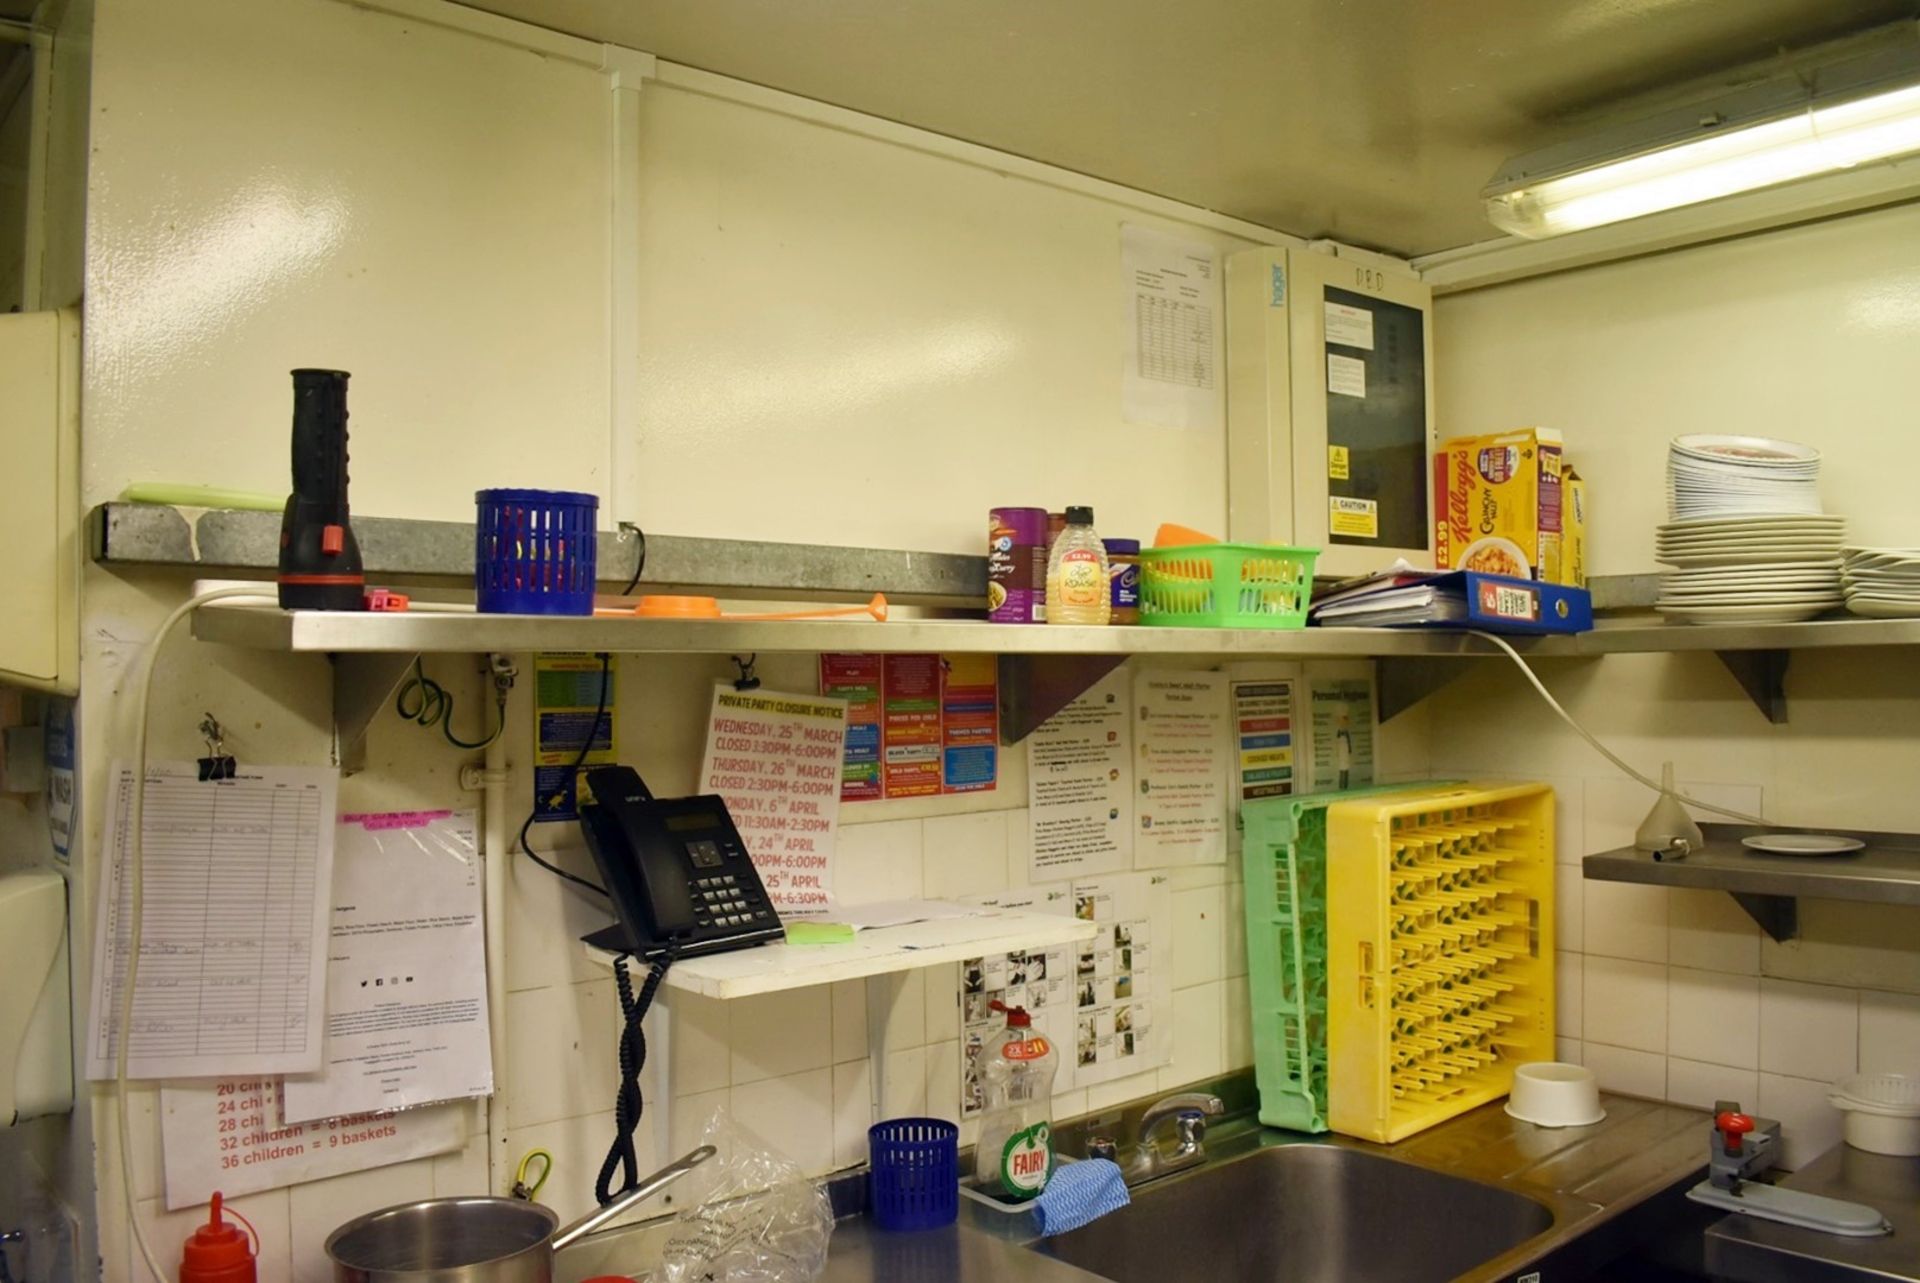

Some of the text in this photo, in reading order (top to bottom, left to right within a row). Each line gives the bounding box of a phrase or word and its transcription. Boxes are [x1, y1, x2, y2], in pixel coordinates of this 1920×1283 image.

[1340, 499, 1367, 511] CAUTION
[1450, 450, 1476, 543] Kellogg's
[1479, 487, 1495, 535] CRUNCHY
[1490, 498, 1499, 519] NUT
[1437, 520, 1448, 565] £2.99
[718, 694, 844, 719] PRIVATE PARTY CLOSURE NOTICE
[779, 722, 804, 739] 25TH
[804, 728, 843, 744] MARCH
[715, 737, 837, 759] CLOSED 3:30PM-6:00PM
[770, 758, 796, 775] 26TH
[796, 764, 835, 780] MARCH
[709, 774, 834, 796] CLOSED 2:30PM-6:00PM
[769, 795, 788, 813] 6TH
[789, 800, 819, 816] APRIL
[744, 815, 830, 833] 11:30AM-2:30PM
[759, 832, 784, 850] 24TH
[785, 837, 816, 852] APRIL
[766, 870, 821, 889] 25TH APRIL
[216, 1082, 235, 1096] 20
[217, 1099, 235, 1115] 24
[218, 1117, 236, 1133] 28
[219, 1136, 238, 1151] 32
[221, 1154, 239, 1170] 36
[243, 1143, 304, 1165] children
[329, 1134, 338, 1148] 9
[342, 1125, 397, 1145] baskets
[1013, 1149, 1046, 1176] FAIRY
